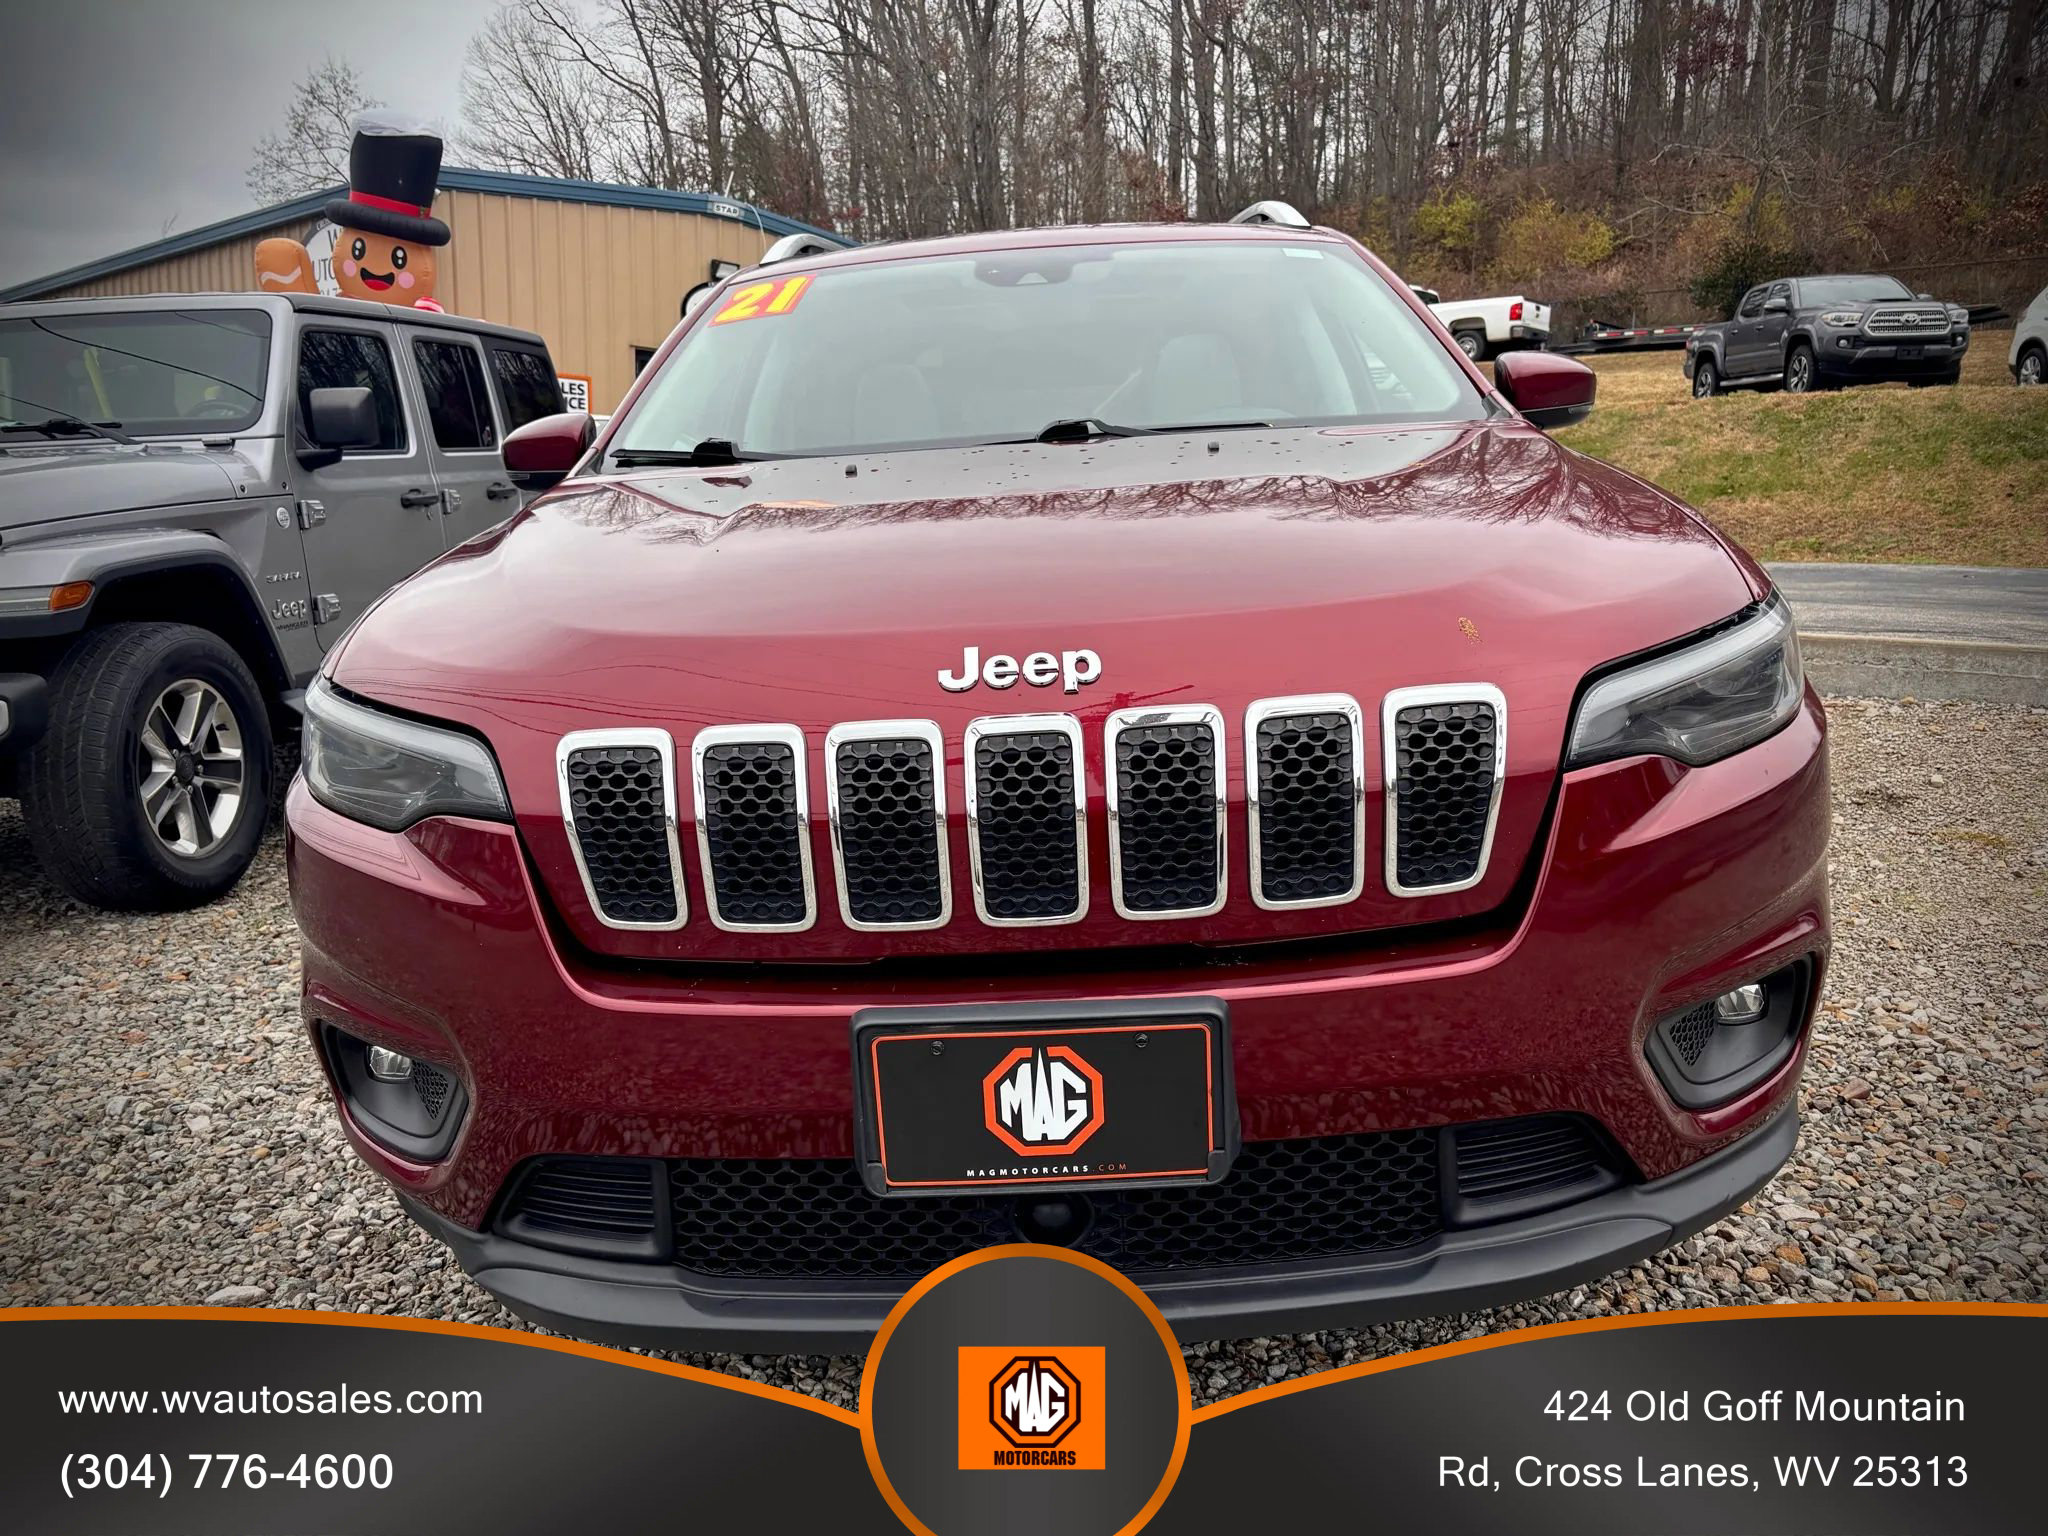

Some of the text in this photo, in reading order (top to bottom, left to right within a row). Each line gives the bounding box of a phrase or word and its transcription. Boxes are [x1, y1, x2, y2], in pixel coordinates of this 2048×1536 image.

[713, 276, 810, 323] 21
[561, 382, 585, 396] LES
[271, 599, 306, 620] Jeep
[937, 646, 1102, 695] Jeep
[999, 1046, 1088, 1142] MAG
